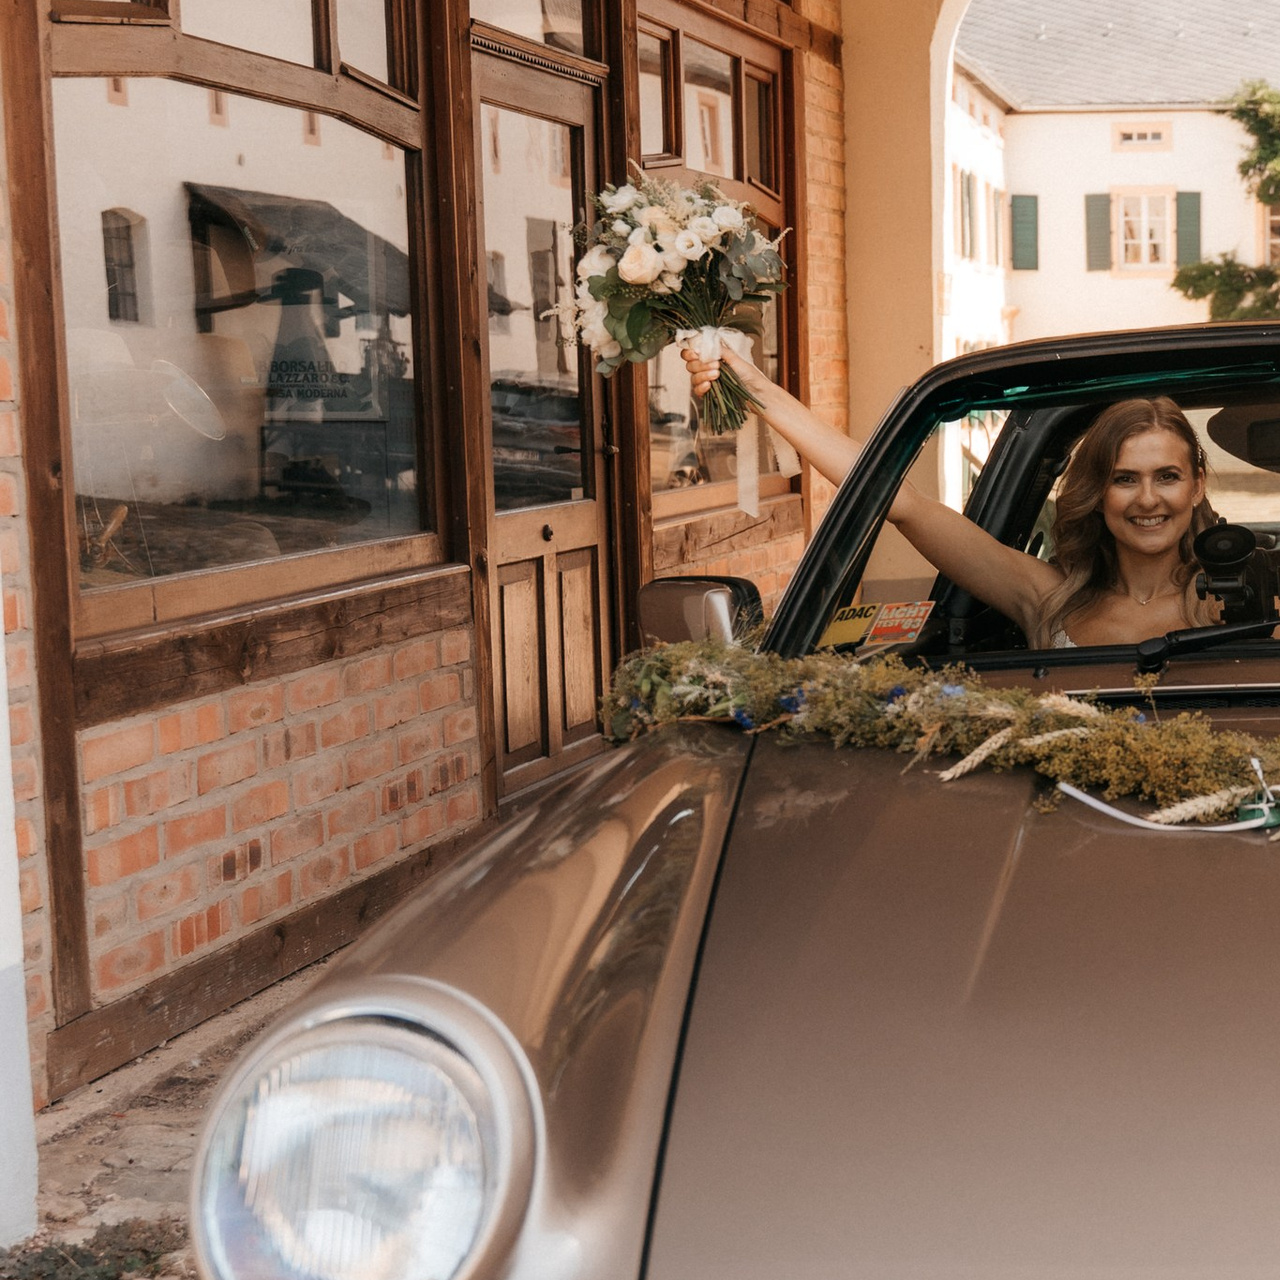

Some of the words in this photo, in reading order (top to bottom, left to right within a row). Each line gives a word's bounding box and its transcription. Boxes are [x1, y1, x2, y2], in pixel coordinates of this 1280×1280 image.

[297, 388, 348, 398] MODERNA
[834, 605, 877, 622] ADAC
[880, 606, 930, 619] LICHT
